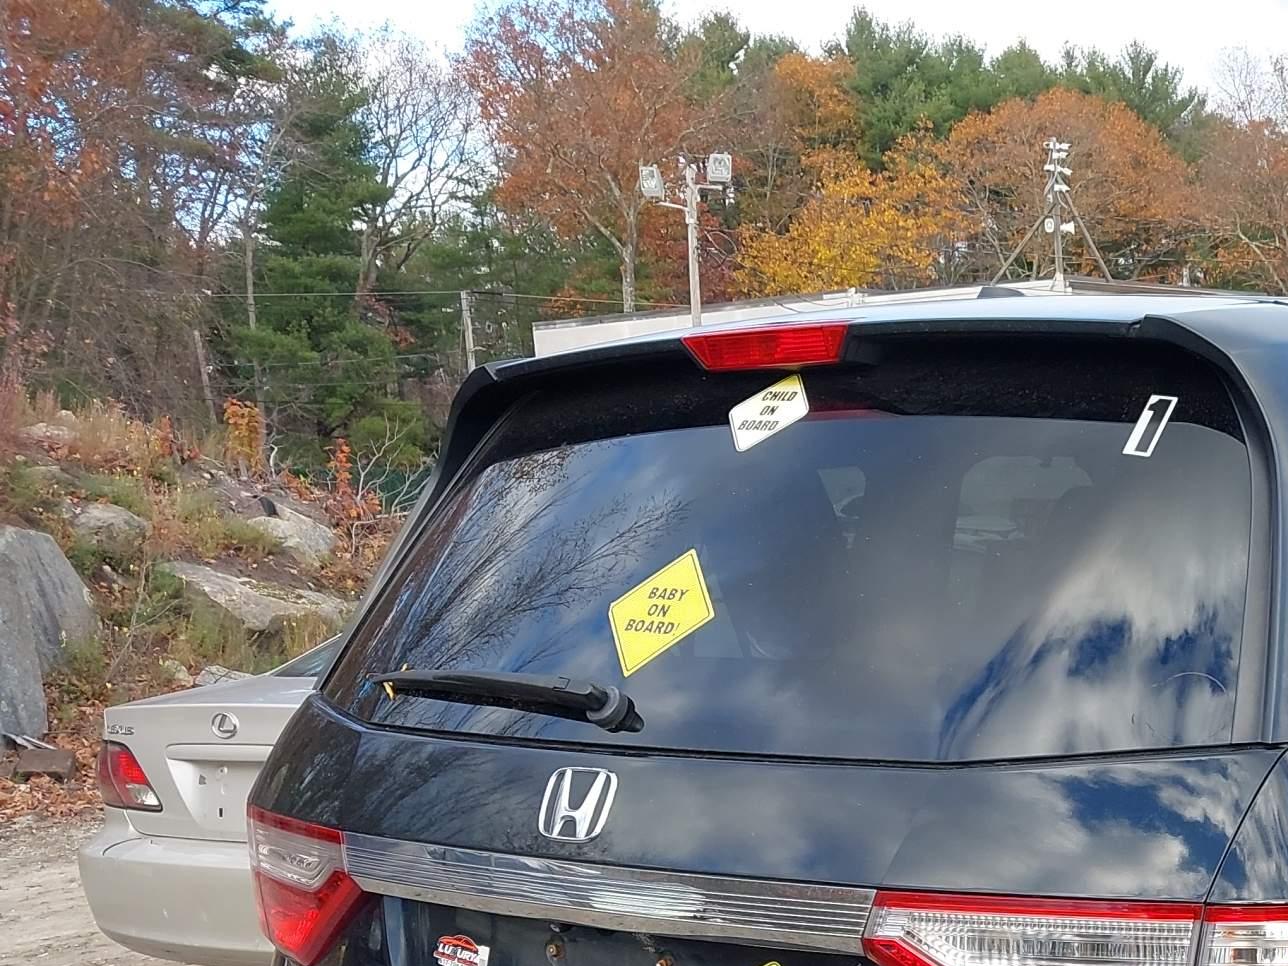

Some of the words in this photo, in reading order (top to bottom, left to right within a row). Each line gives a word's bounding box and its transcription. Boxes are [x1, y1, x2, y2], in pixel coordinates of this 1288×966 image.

[761, 391, 799, 402] CHILD
[760, 405, 779, 416] ON
[737, 420, 780, 431] BOARD
[648, 587, 690, 601] BABY
[647, 603, 671, 618] ON
[624, 618, 681, 636] BOARD!
